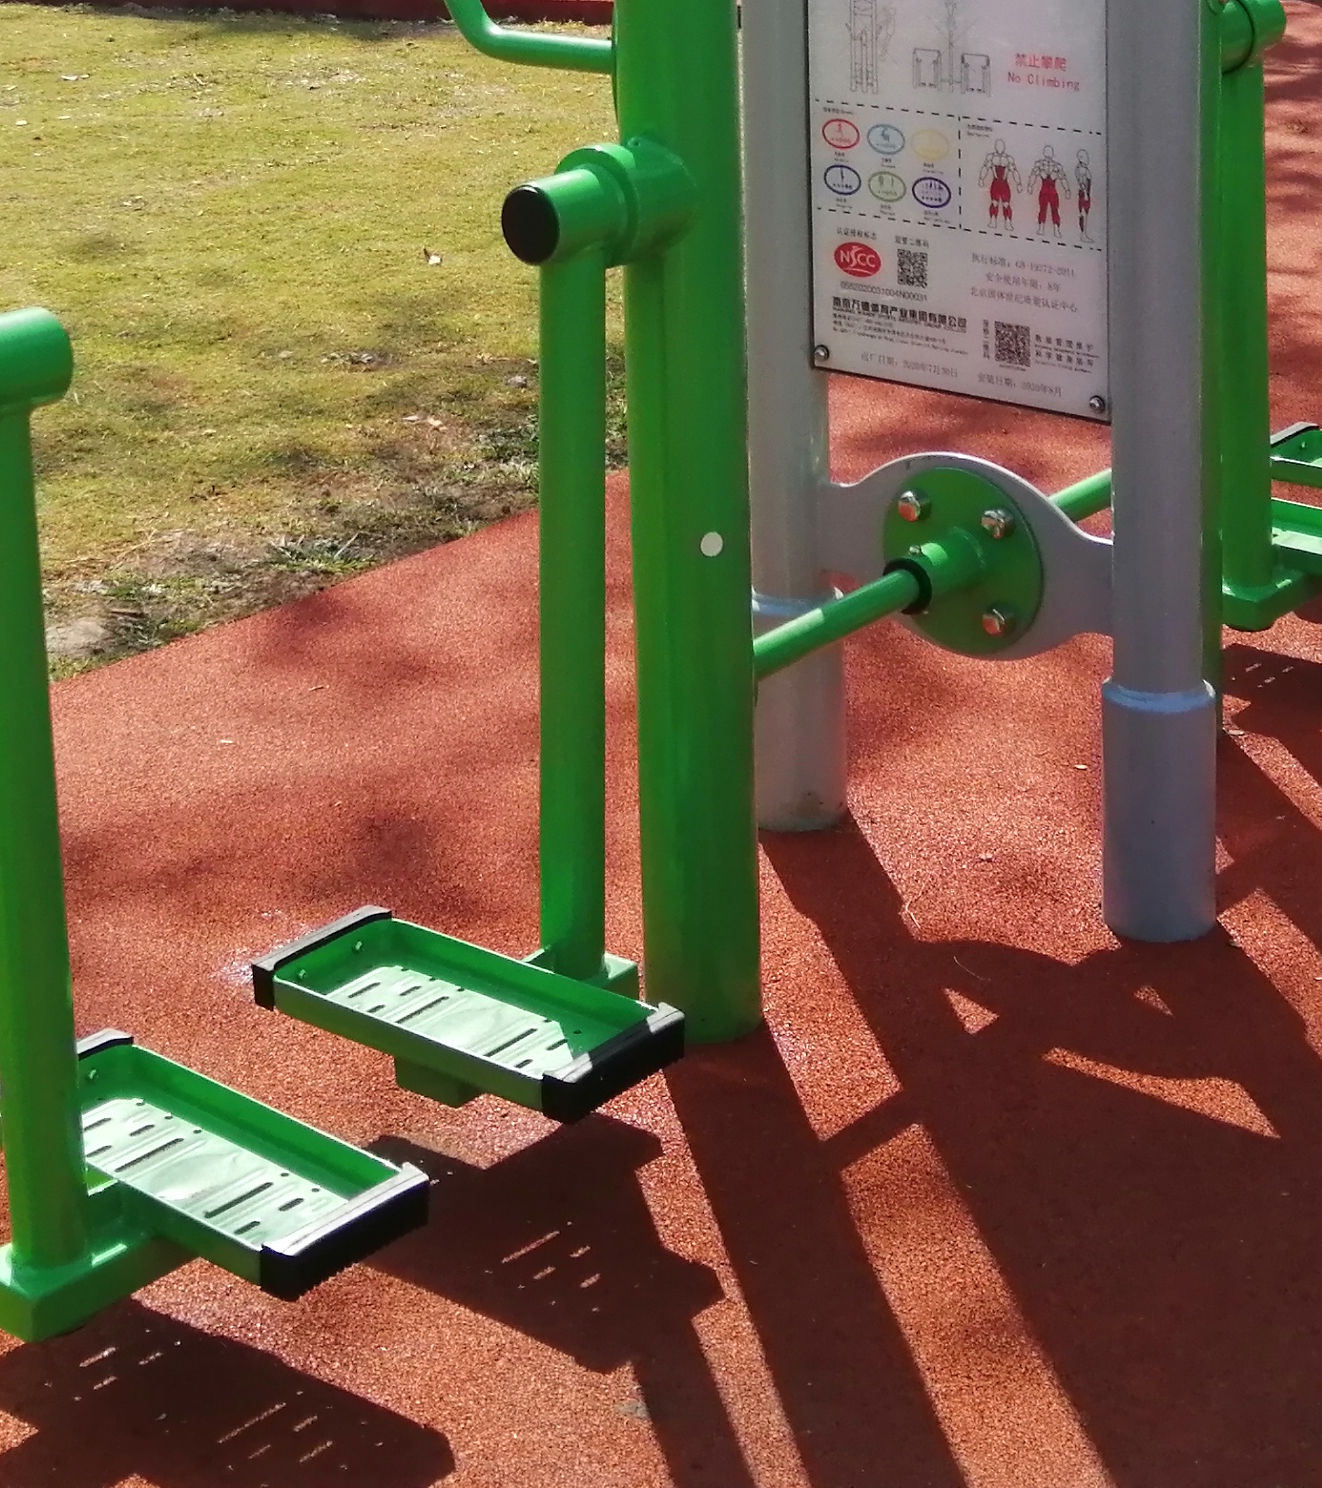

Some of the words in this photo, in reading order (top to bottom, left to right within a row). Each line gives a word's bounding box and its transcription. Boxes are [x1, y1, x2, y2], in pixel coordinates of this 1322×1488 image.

[1015, 53, 1067, 72] 禁止攀爬
[1007, 71, 1021, 84] No
[1027, 73, 1080, 92] Climbing
[840, 245, 876, 268] NSCC
